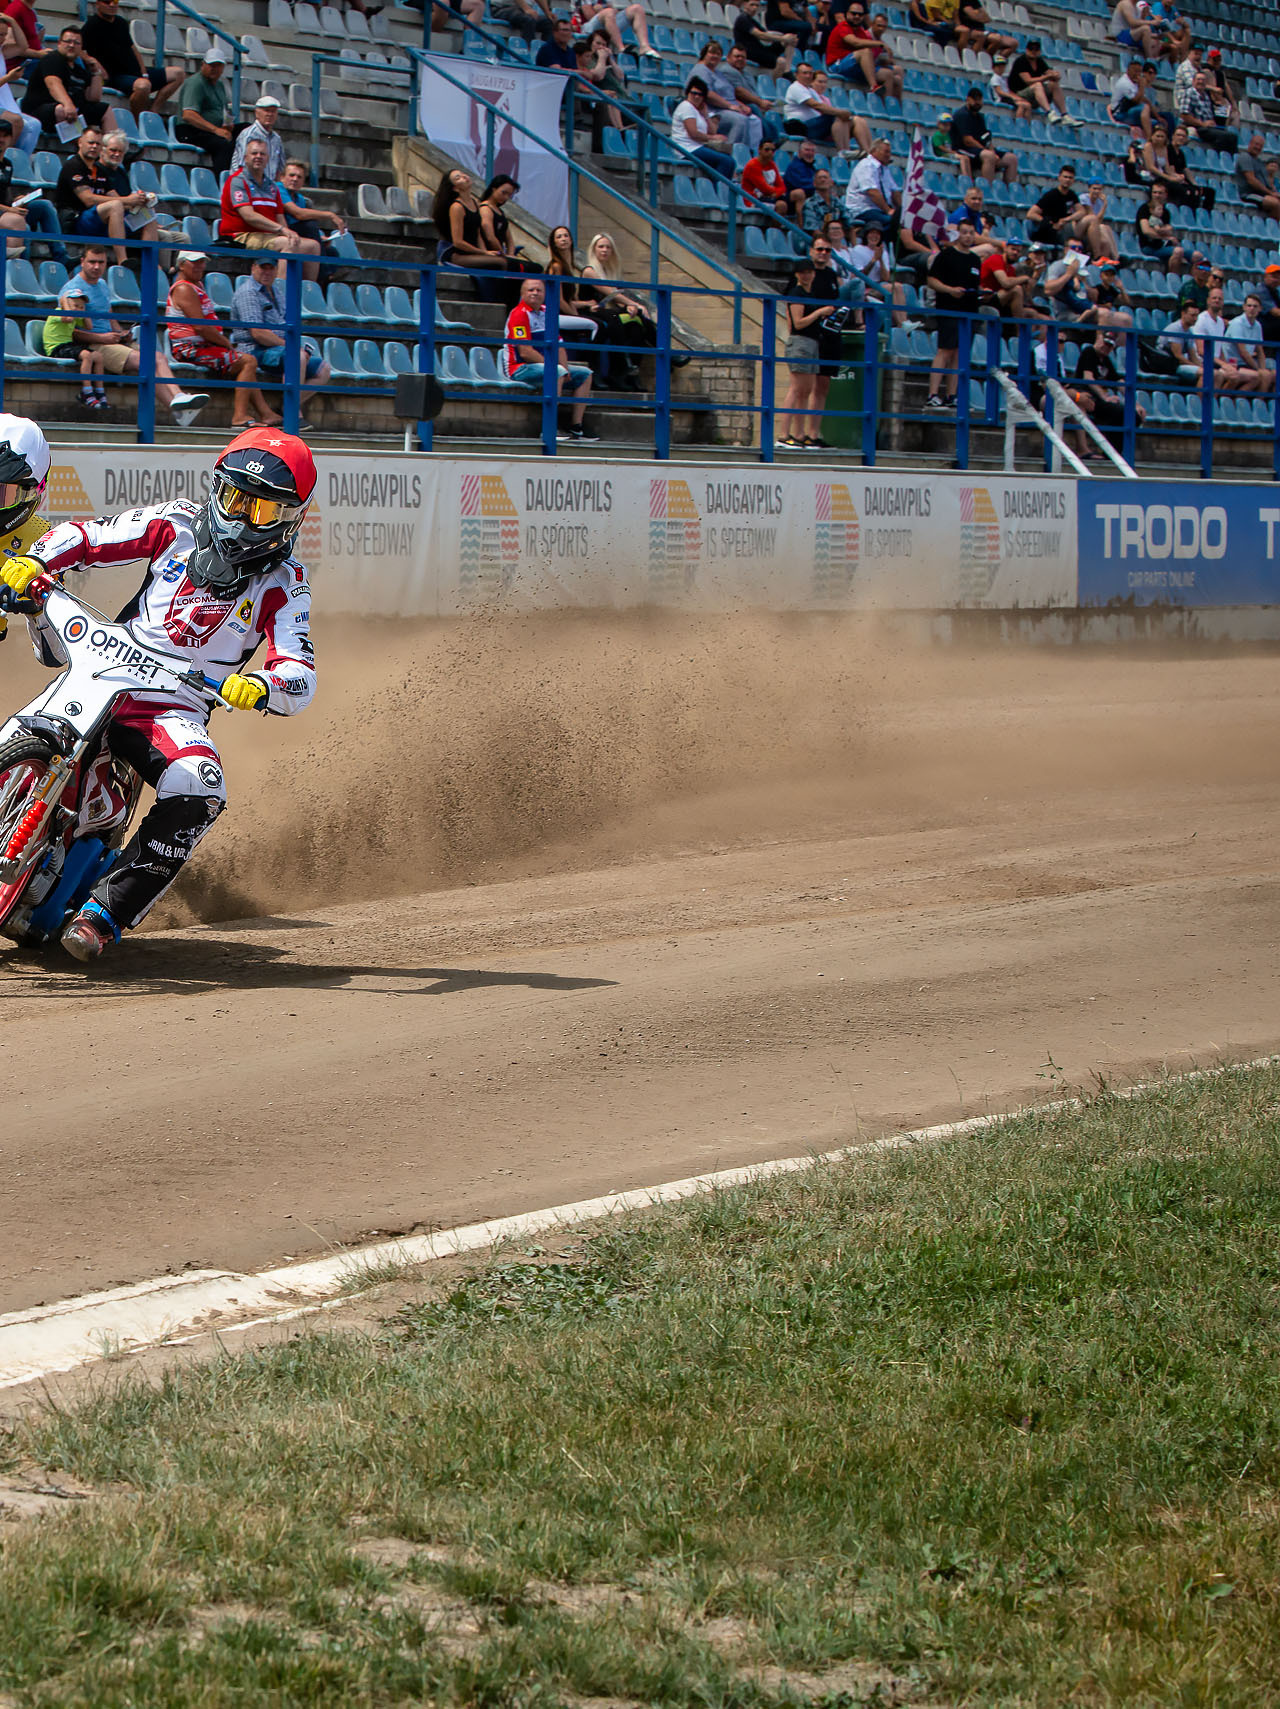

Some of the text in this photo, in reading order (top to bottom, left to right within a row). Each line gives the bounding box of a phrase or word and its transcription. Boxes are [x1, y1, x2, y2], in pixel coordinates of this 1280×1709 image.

[105, 469, 210, 506] DAUGAVPILS
[329, 472, 421, 508] DAUGAVPILS
[525, 478, 612, 512] DAUGAVPILS
[706, 483, 782, 515] DAUGAVPILS
[864, 486, 931, 518] DAUGAVPILS
[1004, 490, 1066, 519] DAUGAVPILS
[329, 522, 415, 556] IS SPEEDWAY
[526, 525, 589, 557] IR SPORTS
[706, 527, 777, 558] IS SPEEDWAY
[877, 529, 912, 558] SPORTS
[1016, 531, 1062, 558] SPEEDWAY
[1095, 504, 1228, 559] TRODO
[91, 630, 164, 679] OPTIBET
